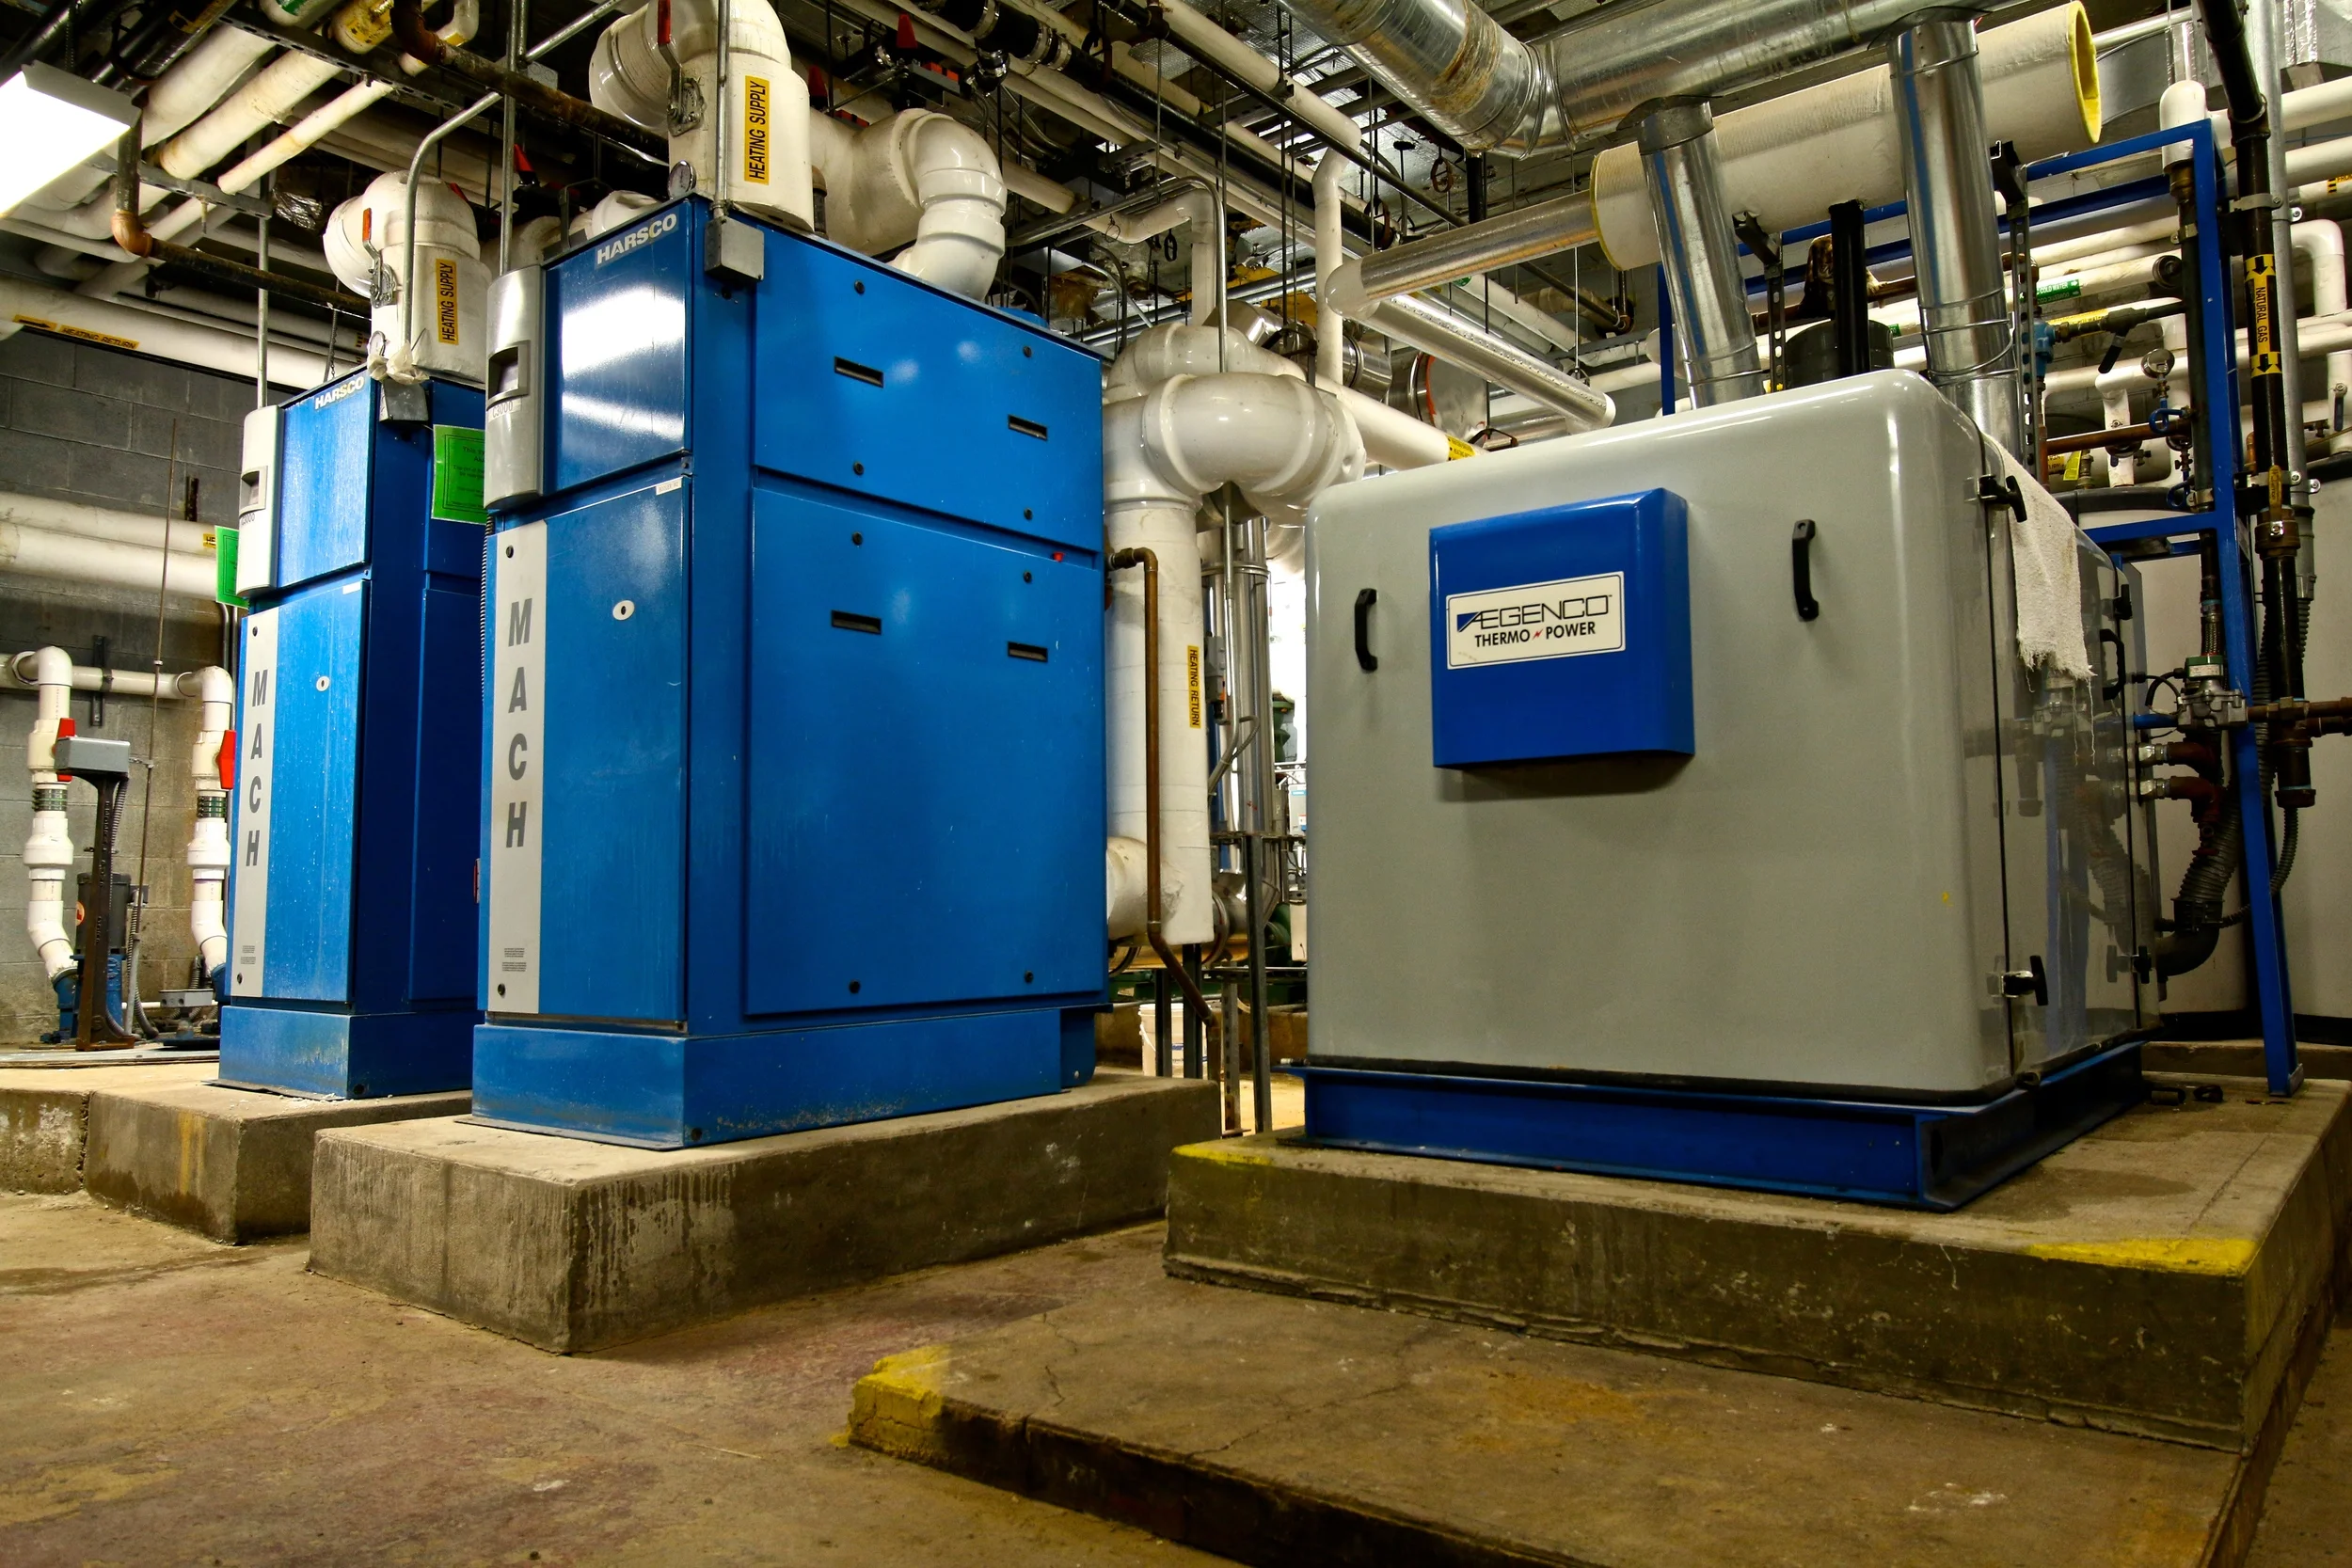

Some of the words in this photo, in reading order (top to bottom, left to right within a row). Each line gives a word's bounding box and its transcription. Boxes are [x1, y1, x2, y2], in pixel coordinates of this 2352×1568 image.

[749, 80, 766, 125] SUPPLY
[749, 129, 766, 180] HEATING
[596, 213, 677, 264] HARSCO
[439, 262, 454, 298] SUPPLY
[440, 300, 455, 341] HEATING
[2255, 286, 2267, 324] NATURAL
[63, 327, 99, 341] HEATING
[101, 336, 136, 349] RETURN
[2257, 325, 2268, 343] GAS
[314, 376, 365, 410] HARSCO
[1474, 628, 1531, 648] THERMO
[1546, 621, 1596, 640] POWER
[1190, 649, 1199, 687] HEATING
[506, 597, 532, 848] MACH
[1191, 689, 1200, 726] RETURN
[246, 669, 269, 867] MACH
